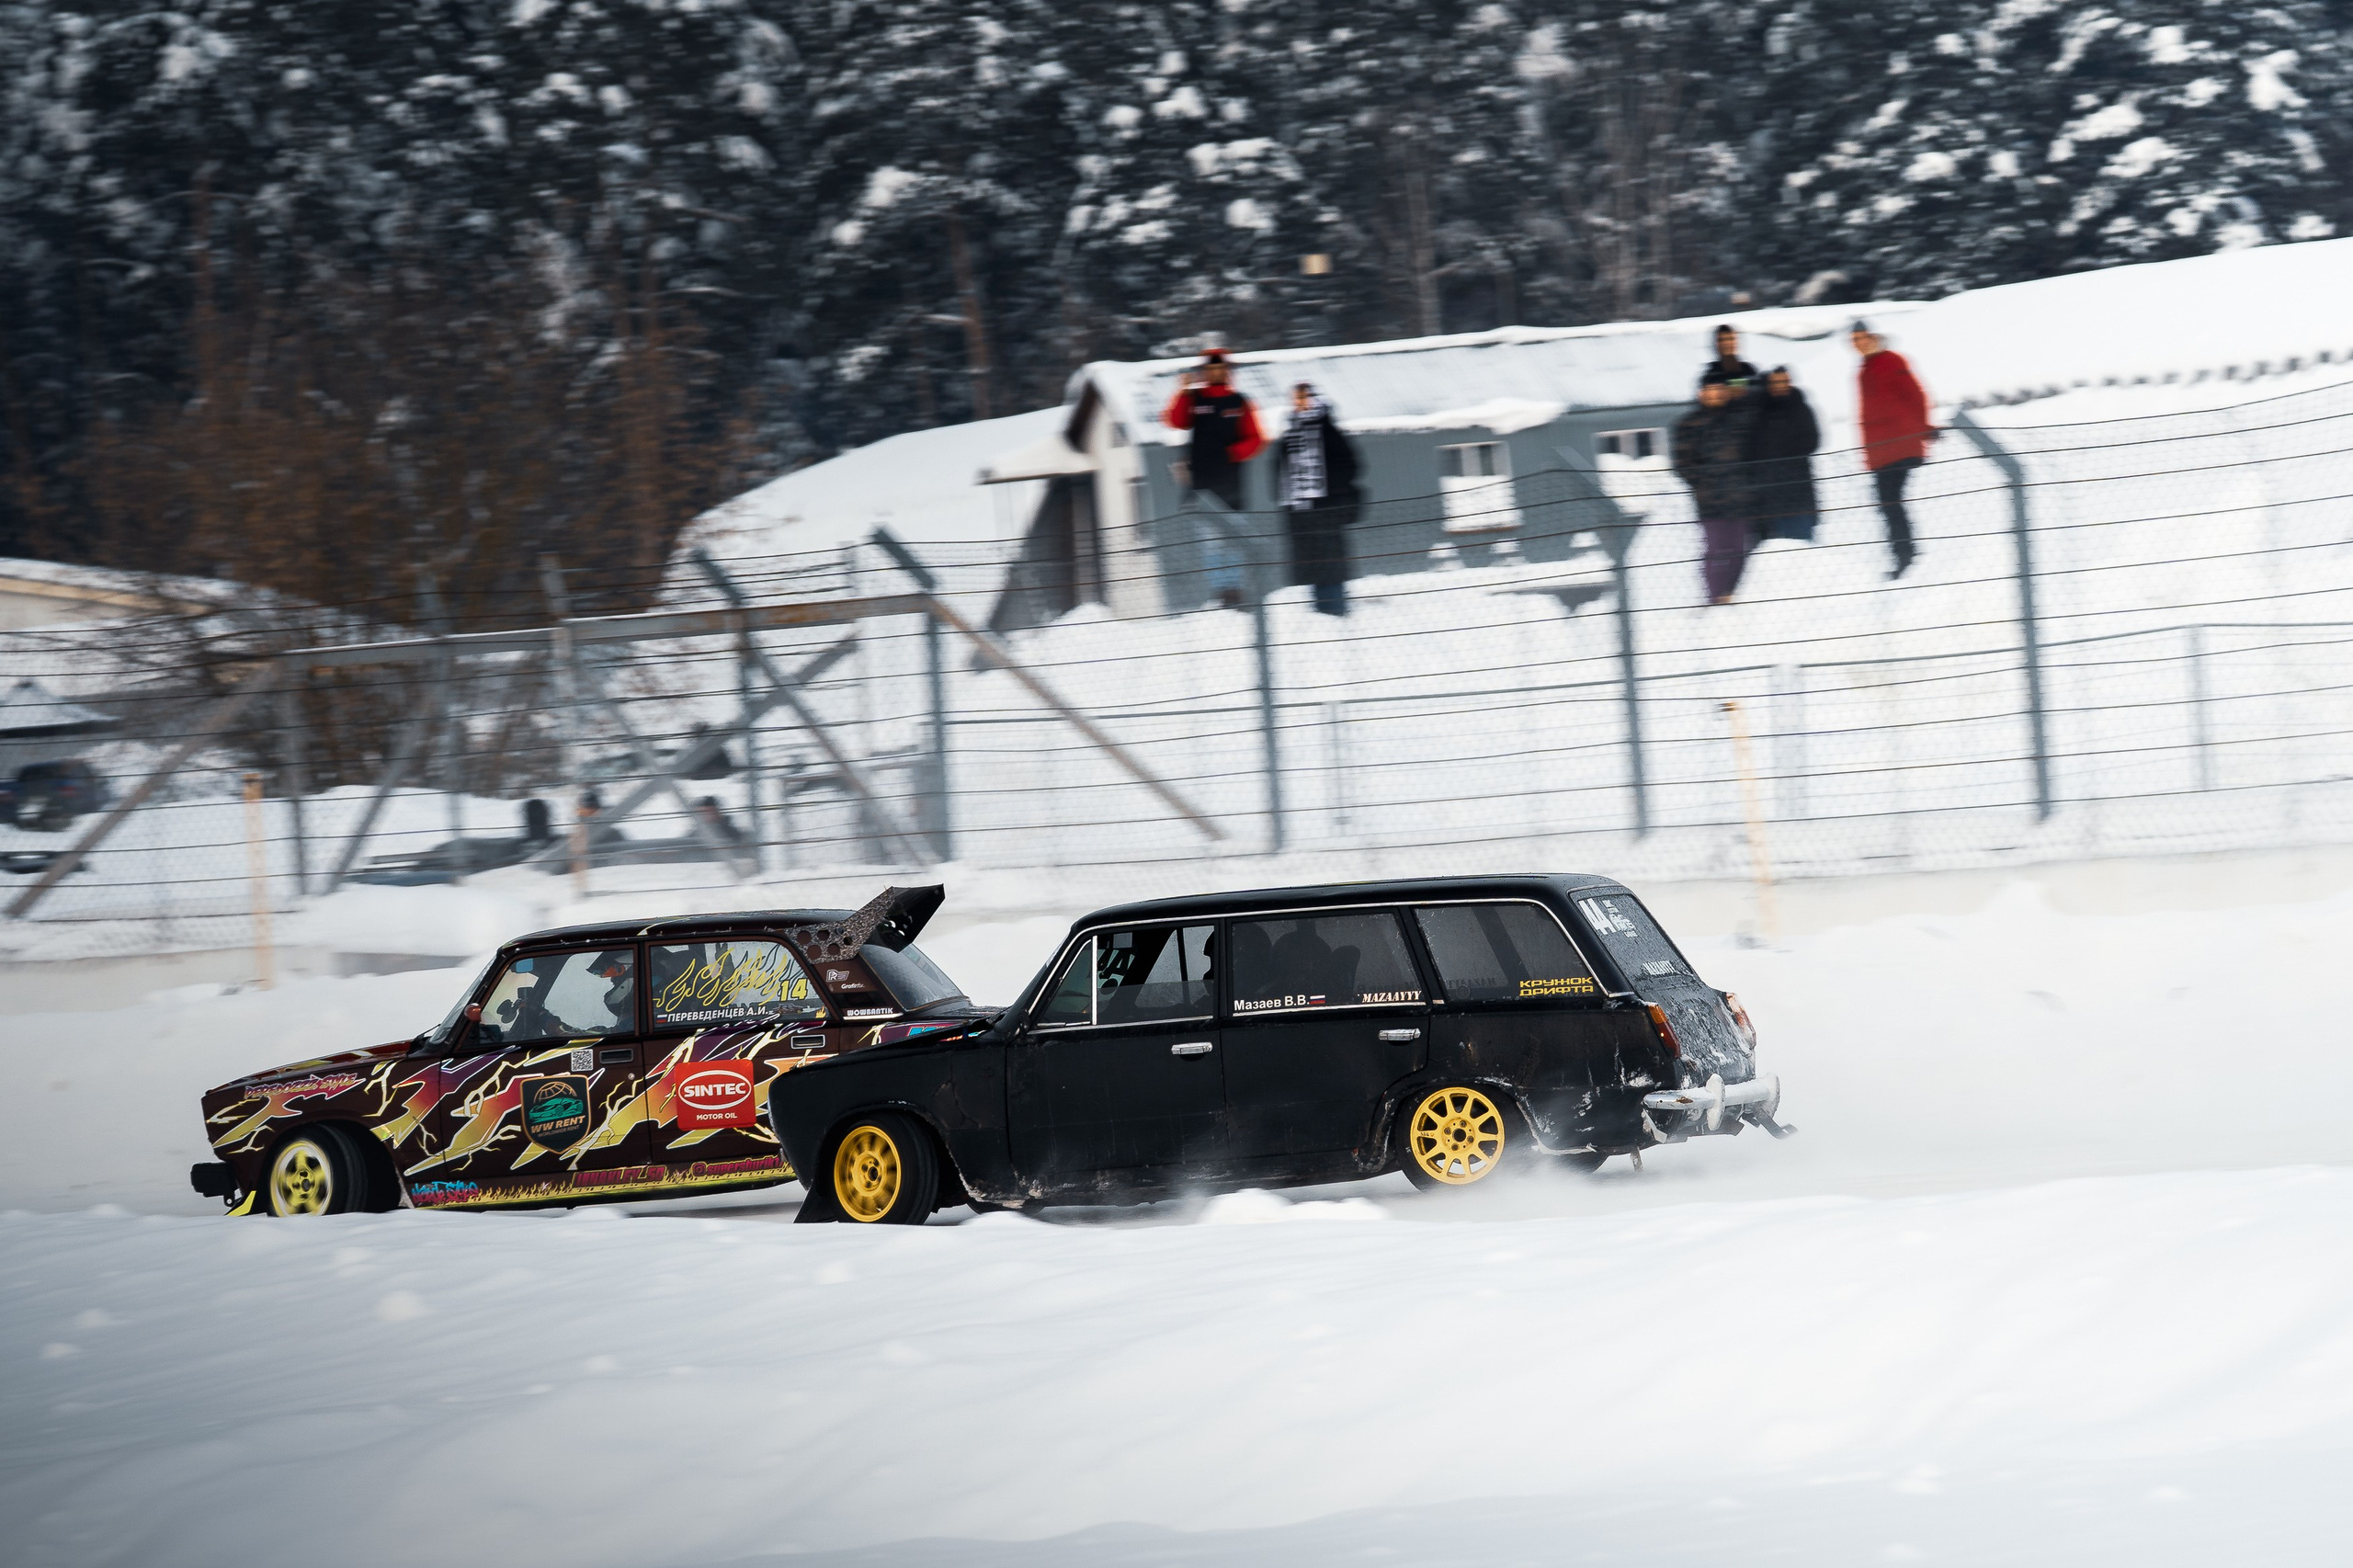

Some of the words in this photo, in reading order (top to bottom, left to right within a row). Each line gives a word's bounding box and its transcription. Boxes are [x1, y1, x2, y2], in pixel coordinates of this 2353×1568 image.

[1578, 897, 1617, 936] 44
[780, 978, 808, 1002] 14
[1519, 976, 1593, 988] КРУЖОК
[1362, 991, 1422, 1004] MAZAAYYY
[1519, 985, 1594, 996] ДРИФТА
[1233, 999, 1282, 1011] Мазаев
[1284, 994, 1310, 1007] В.В.
[667, 1009, 745, 1023] ПЕРЕВЕДЕНЦЕВ
[746, 1006, 769, 1017] А.И.
[683, 1082, 746, 1098] SINTEC
[530, 1120, 555, 1134] WW
[555, 1115, 586, 1130] RENT
[696, 1113, 723, 1121] MOTOR
